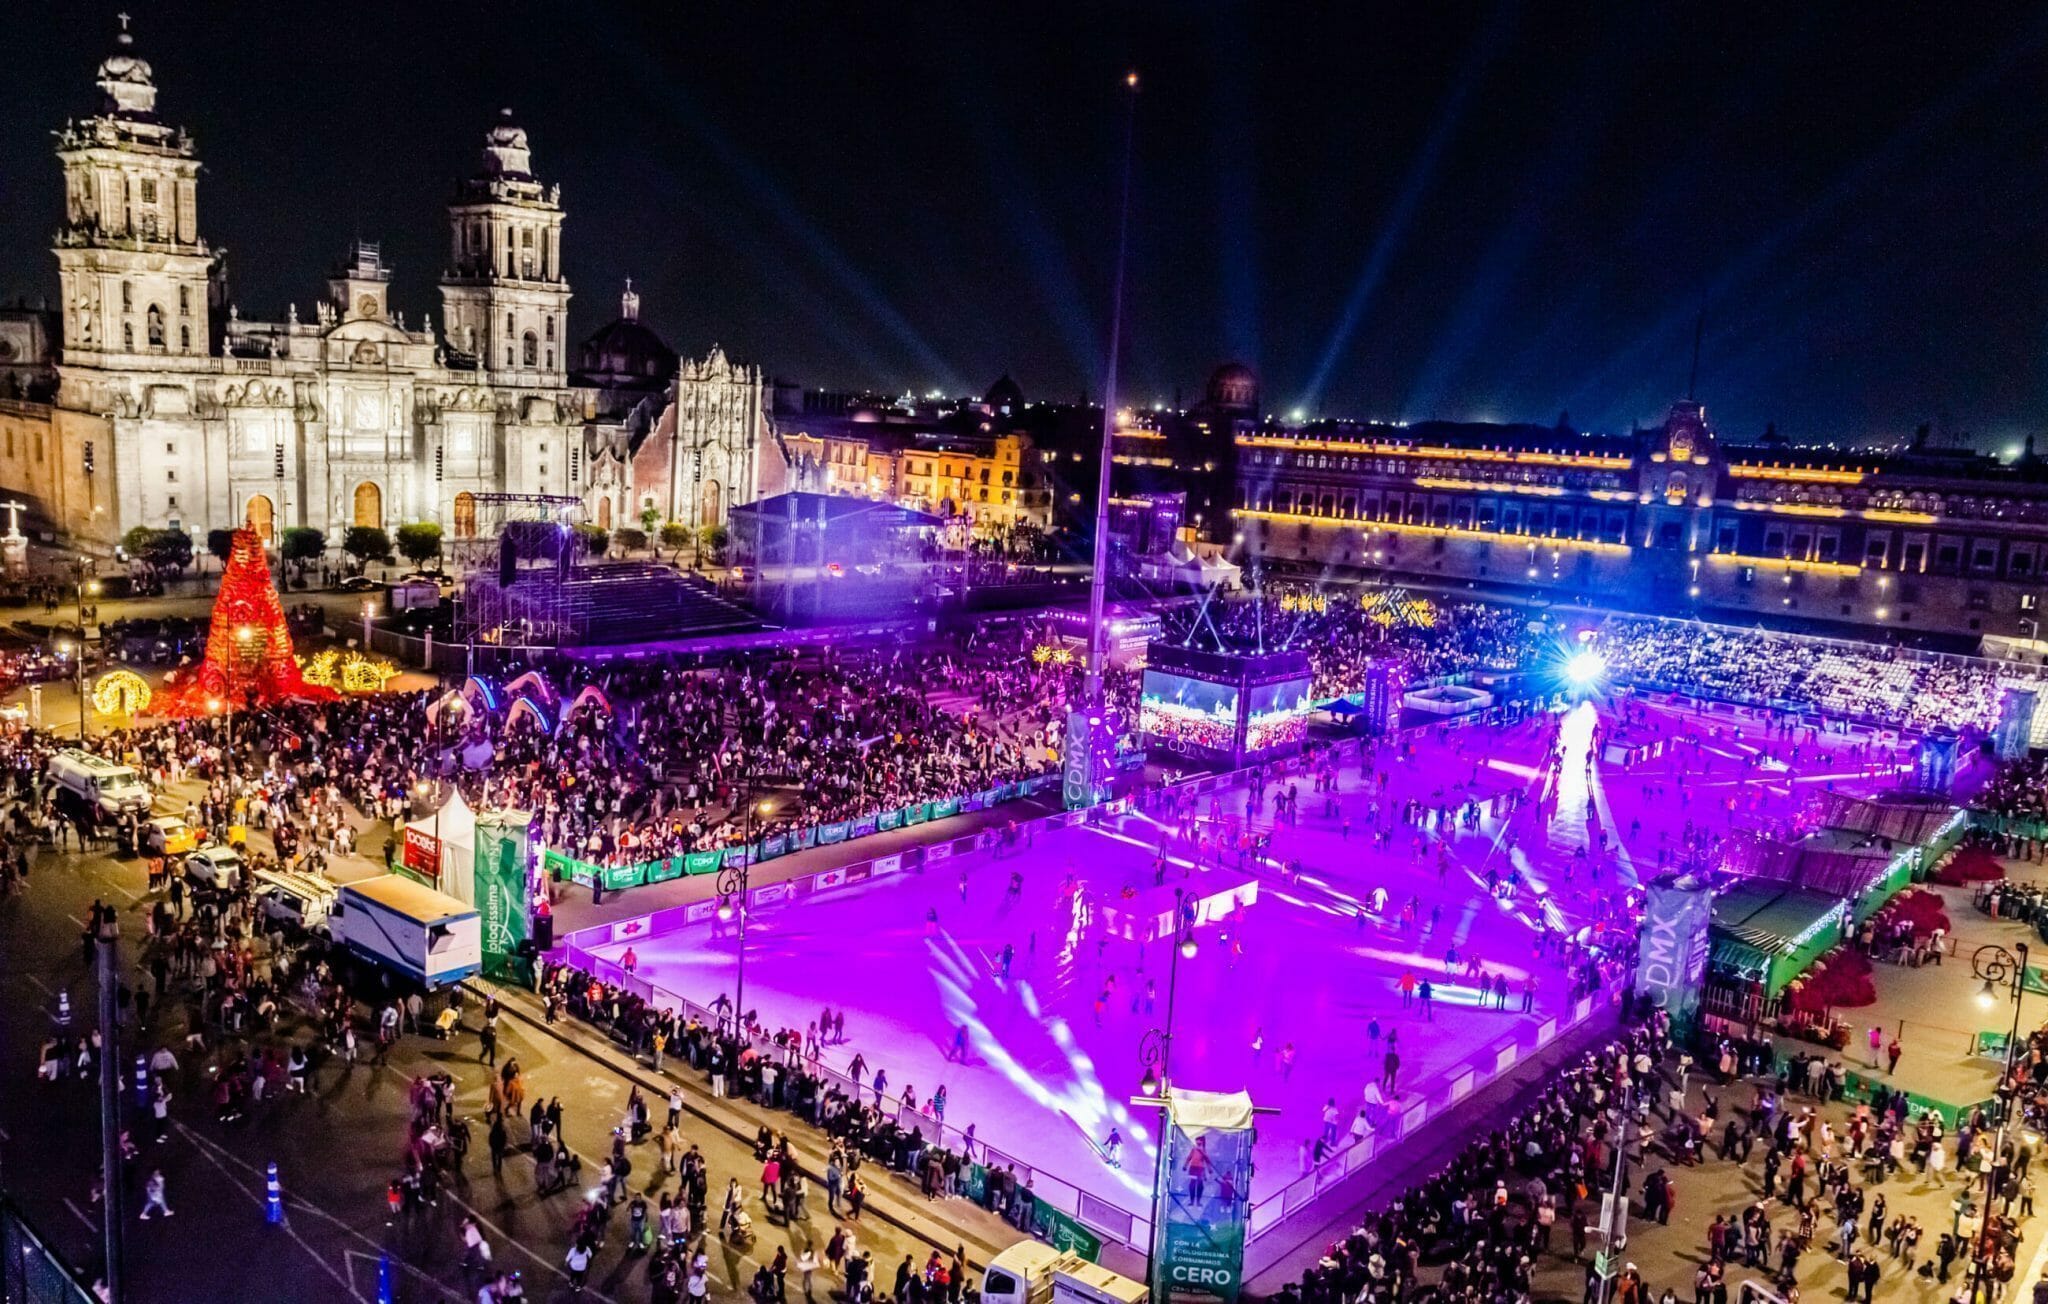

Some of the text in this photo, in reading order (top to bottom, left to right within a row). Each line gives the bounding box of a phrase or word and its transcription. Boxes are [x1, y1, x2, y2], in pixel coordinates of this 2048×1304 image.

[1069, 733, 1085, 801] CDMX
[693, 857, 715, 867] CDMX
[1645, 914, 1678, 1007] CDMX
[1172, 1265, 1231, 1285] CERO
